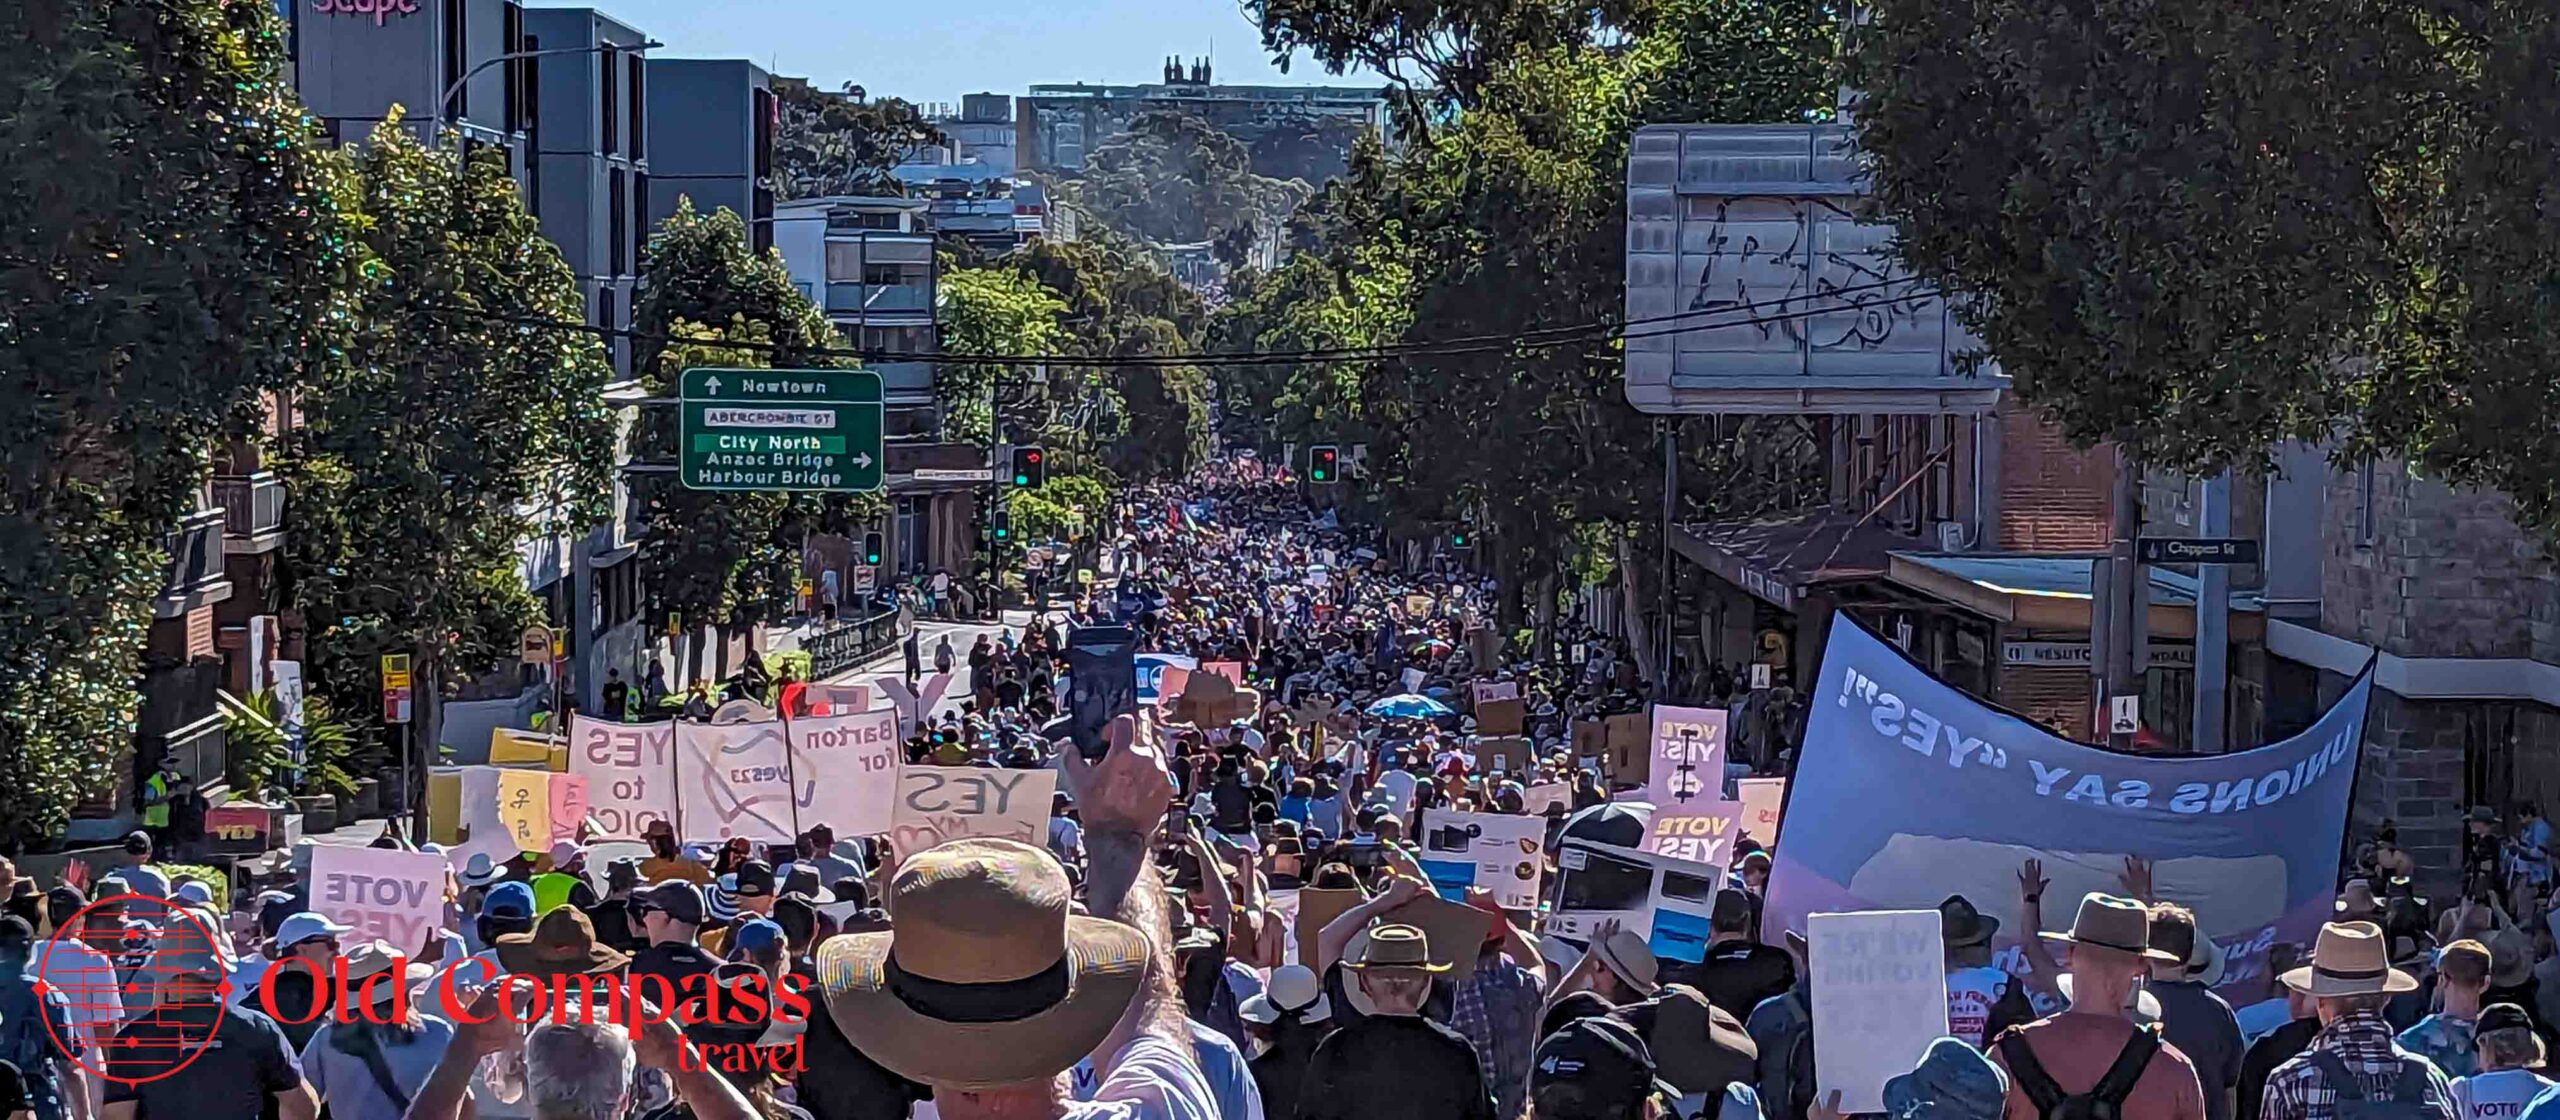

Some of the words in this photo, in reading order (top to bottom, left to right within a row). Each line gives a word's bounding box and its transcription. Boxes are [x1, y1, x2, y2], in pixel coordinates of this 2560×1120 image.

[743, 379, 827, 394] Newtown
[709, 411, 808, 424] ABERCROMBIE
[814, 413, 832, 425] ST
[719, 435, 759, 451] City
[769, 435, 822, 450] North
[706, 452, 766, 466] Anzac
[773, 453, 834, 470] Bridge
[699, 470, 776, 485] Harbour
[781, 470, 842, 487] Bridge
[216, 825, 257, 840] YES
